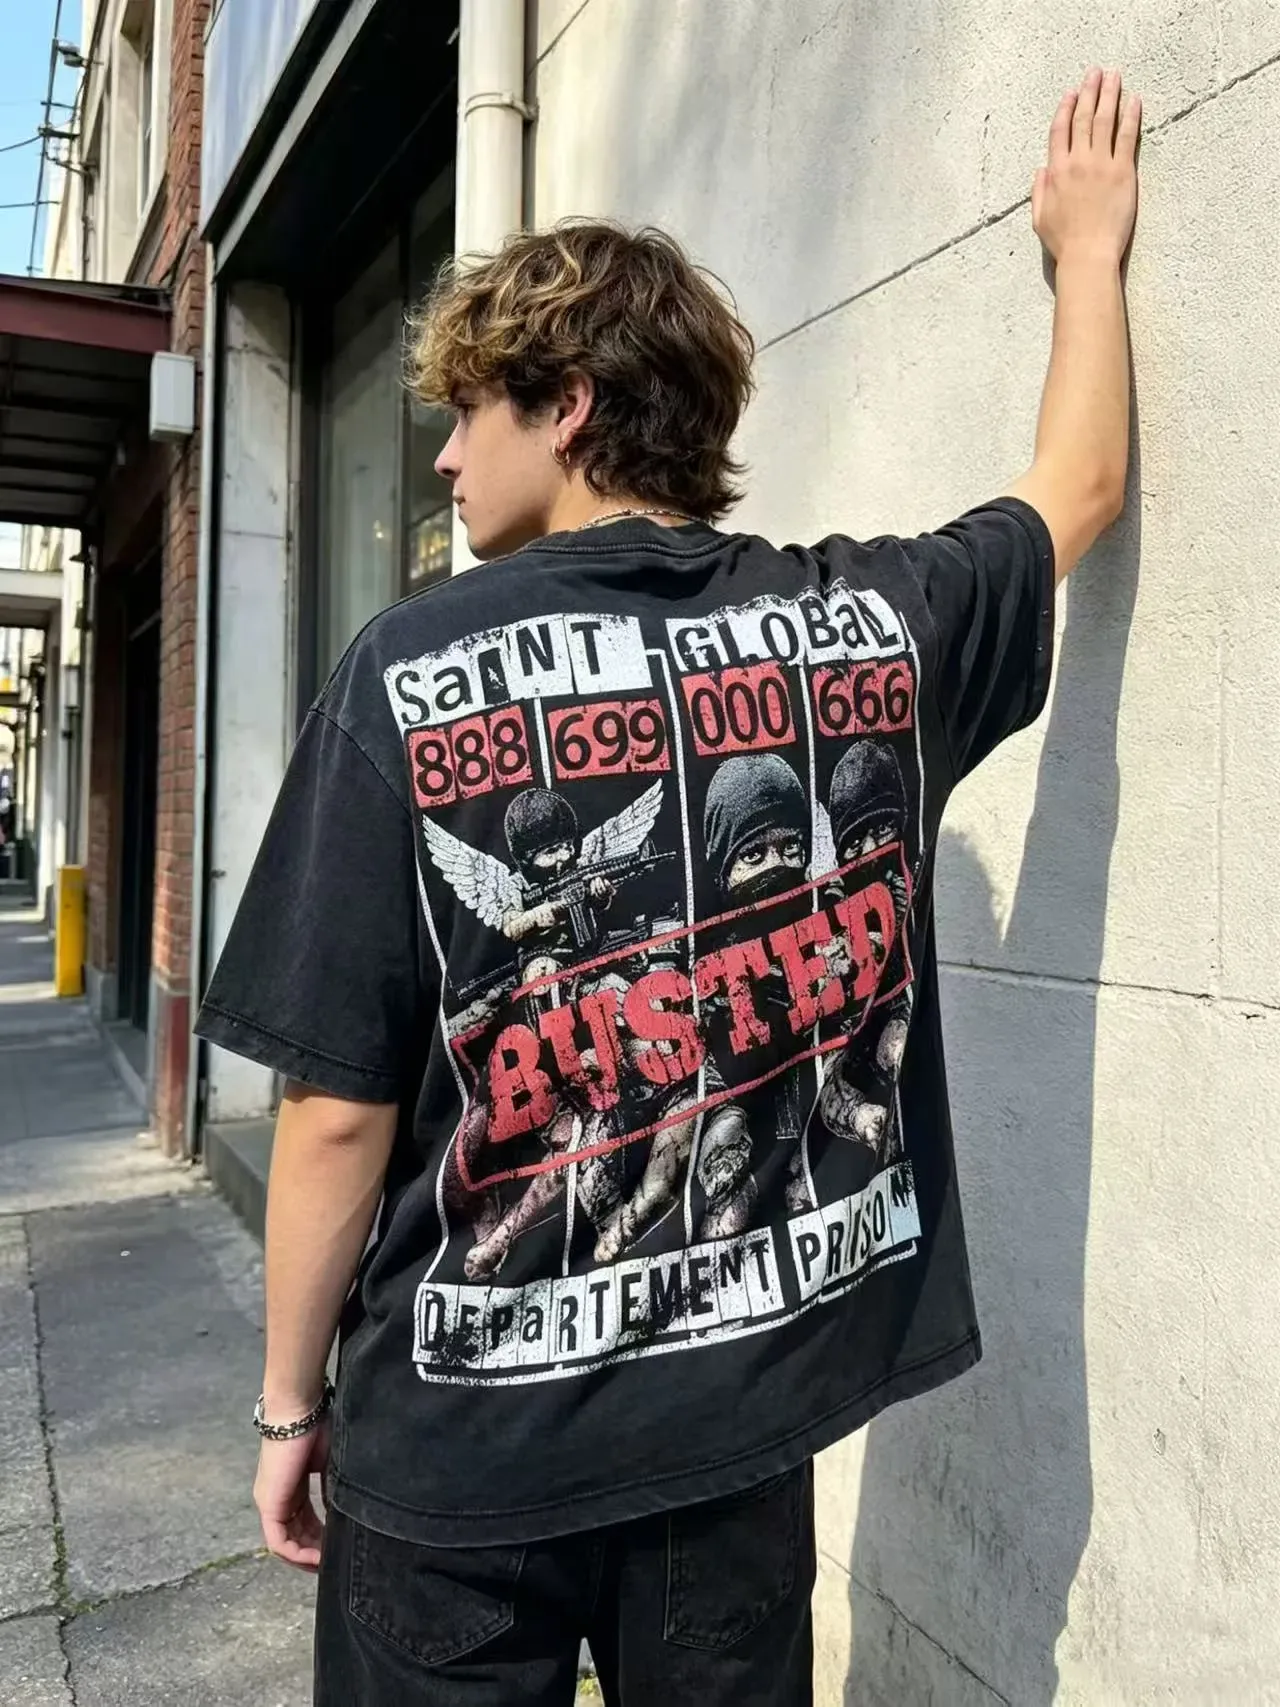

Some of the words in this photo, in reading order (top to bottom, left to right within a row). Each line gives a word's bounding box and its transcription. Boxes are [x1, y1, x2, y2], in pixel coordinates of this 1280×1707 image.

[414, 718, 528, 797] 888
[554, 706, 665, 772] 699
[690, 675, 792, 750] 000
[817, 666, 910, 731] 666
[486, 881, 896, 1143] BUSTED
[795, 1167, 913, 1284] PRISON
